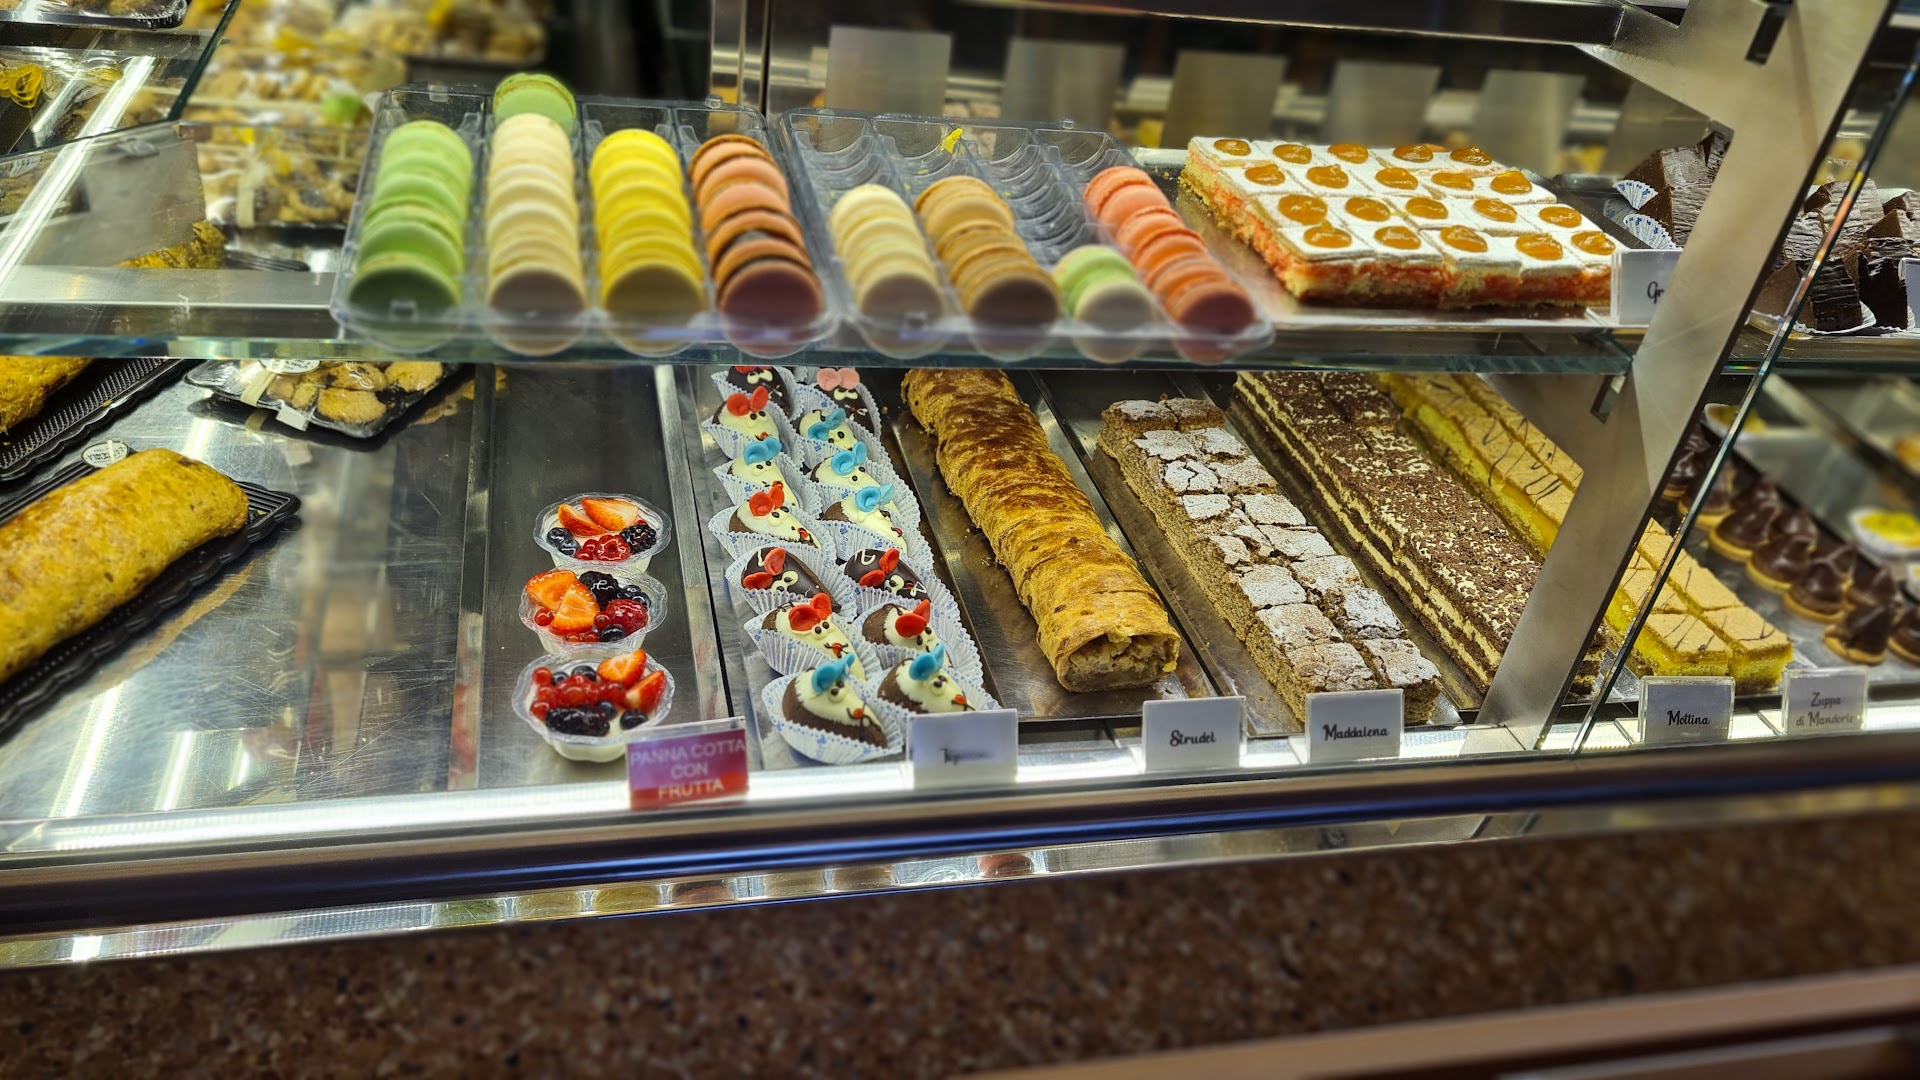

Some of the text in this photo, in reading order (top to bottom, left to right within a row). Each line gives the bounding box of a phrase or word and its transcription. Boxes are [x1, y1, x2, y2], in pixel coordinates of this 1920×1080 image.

[1811, 692, 1841, 709] Zuppa
[1666, 710, 1710, 726] Mottina
[1796, 715, 1804, 726] di
[1169, 729, 1217, 747] Strudel
[1323, 724, 1389, 741] Maddalena
[630, 738, 746, 767] PANNA COTTA
[670, 761, 709, 780] CON
[659, 777, 725, 800] FRUTTA
